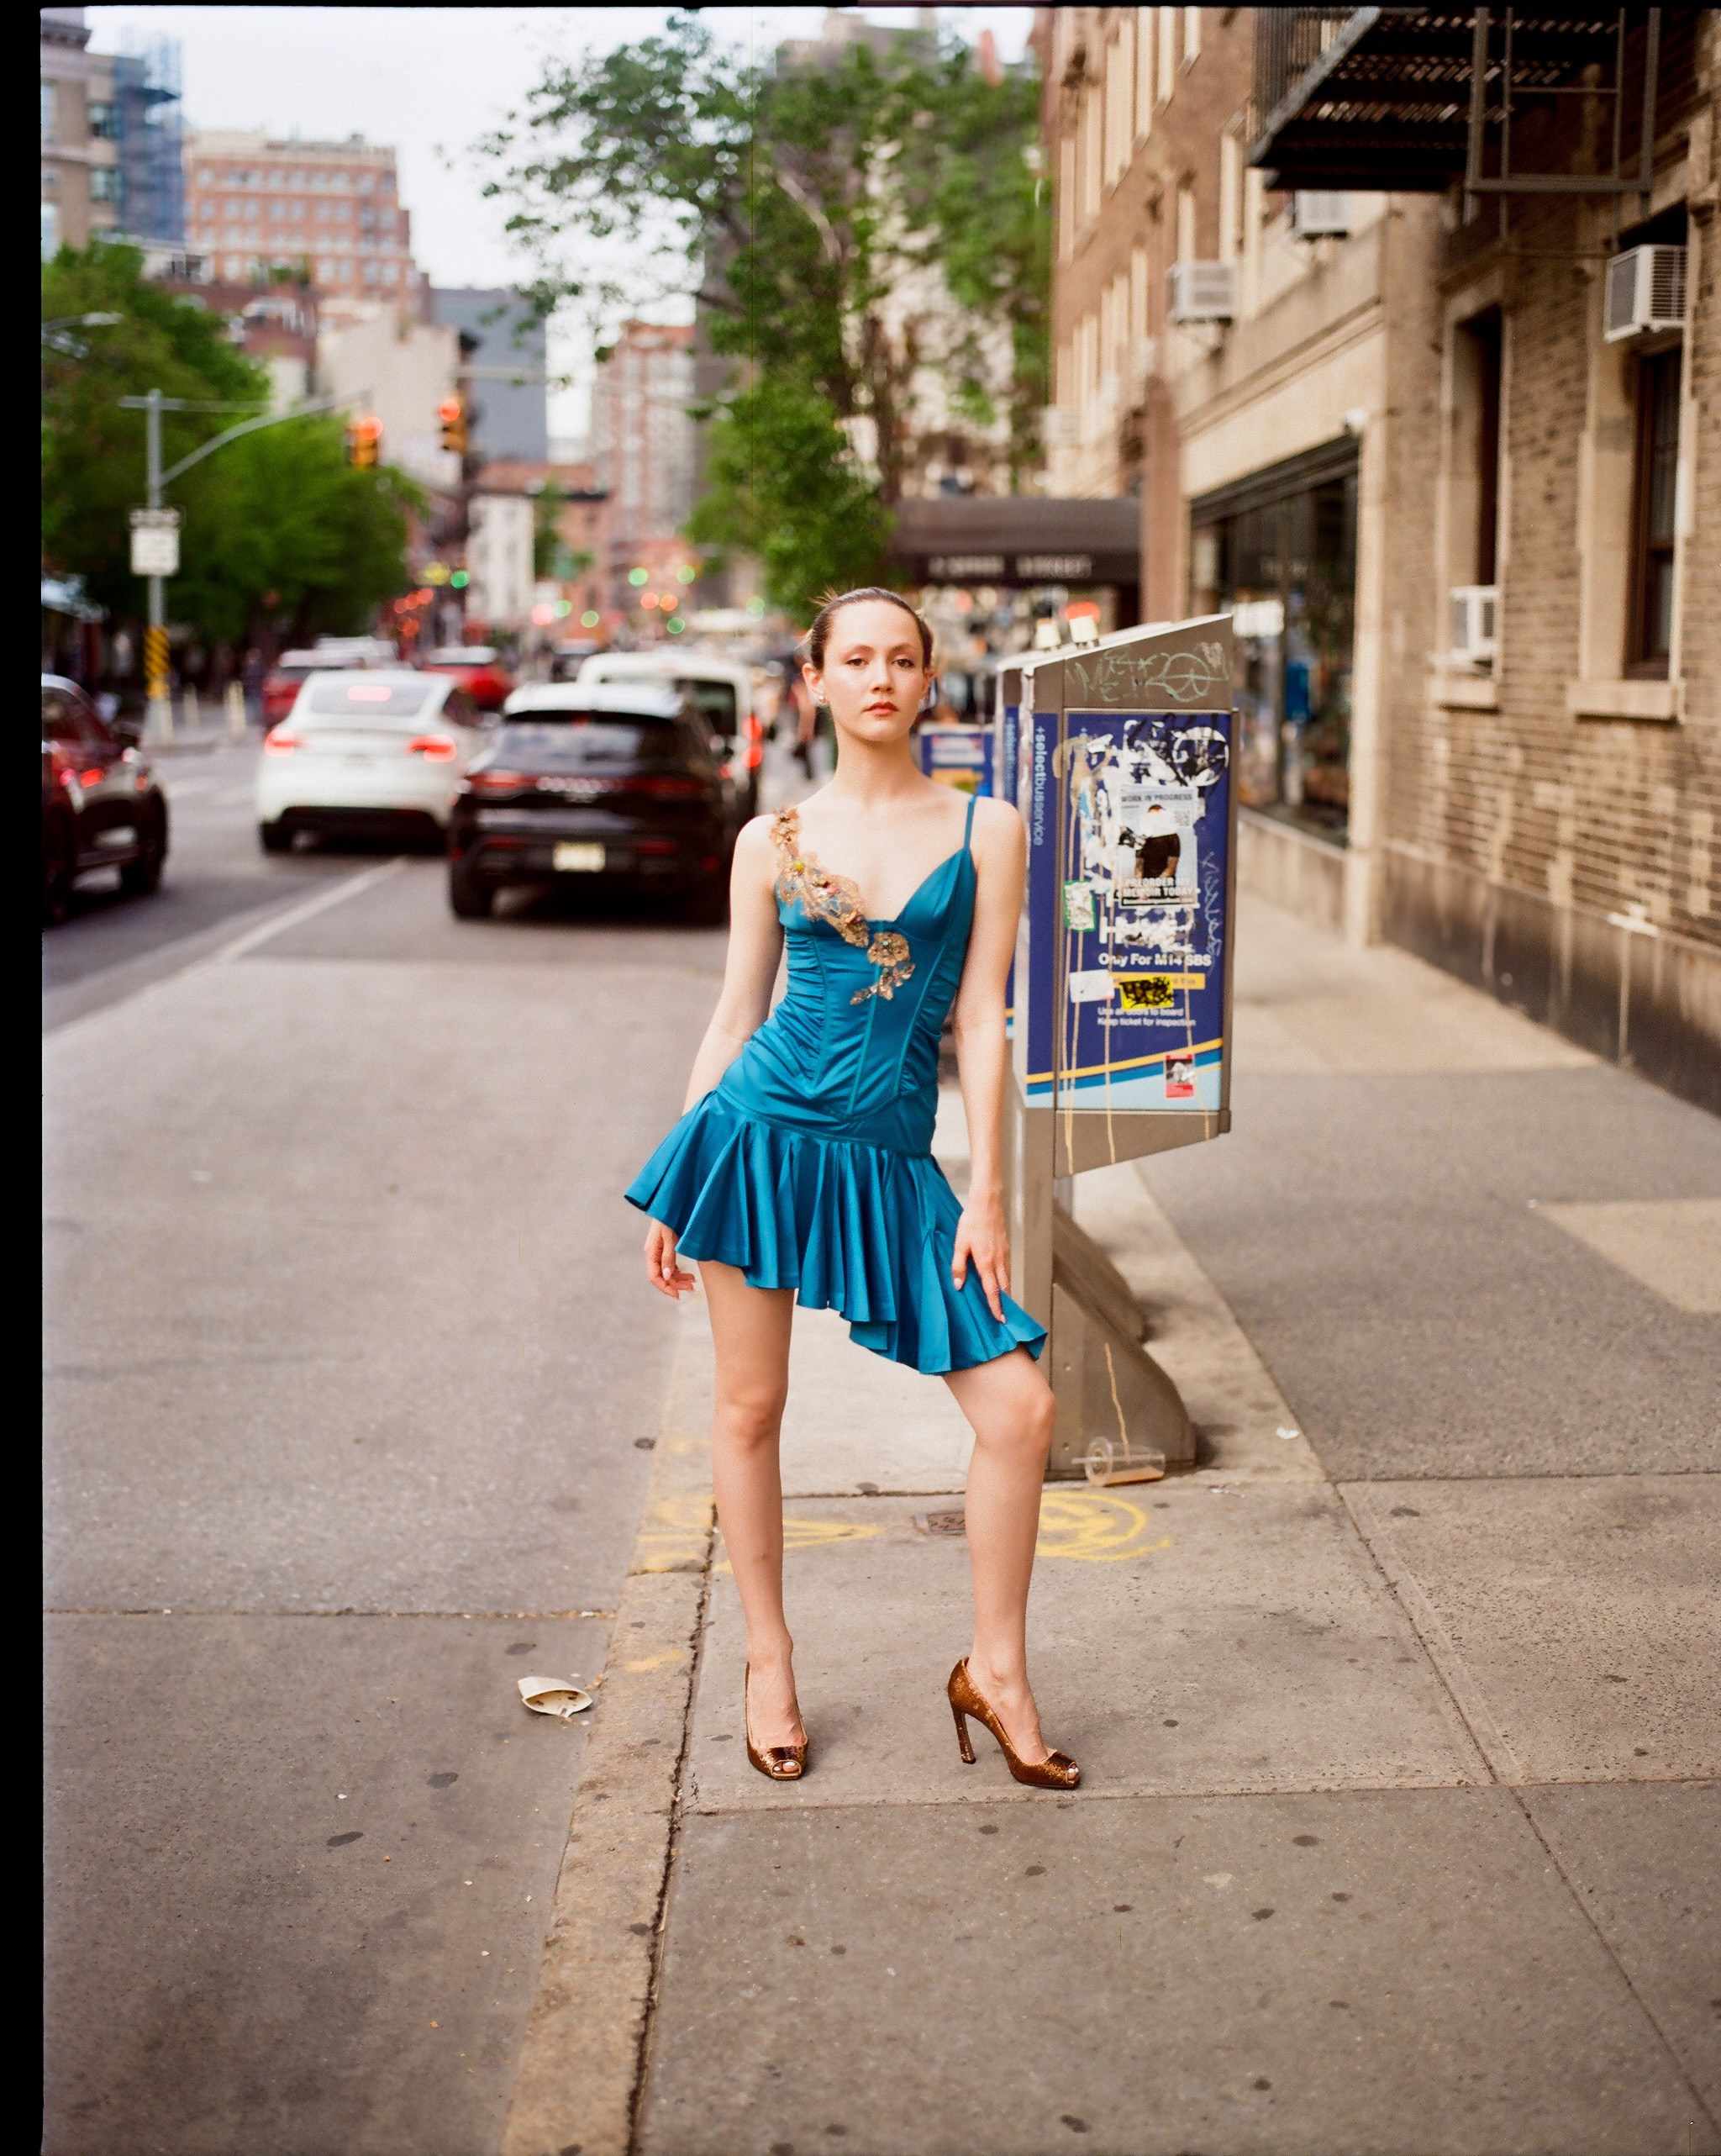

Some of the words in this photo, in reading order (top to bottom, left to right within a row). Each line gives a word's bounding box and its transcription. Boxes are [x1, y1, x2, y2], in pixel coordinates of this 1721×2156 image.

[1154, 793, 1192, 801] PROGRESS
[1124, 877, 1175, 888] PREORDER
[1163, 887, 1193, 897] TODAY
[1130, 952, 1153, 966] For
[1185, 953, 1213, 967] SBS
[1142, 1017, 1155, 1027] for
